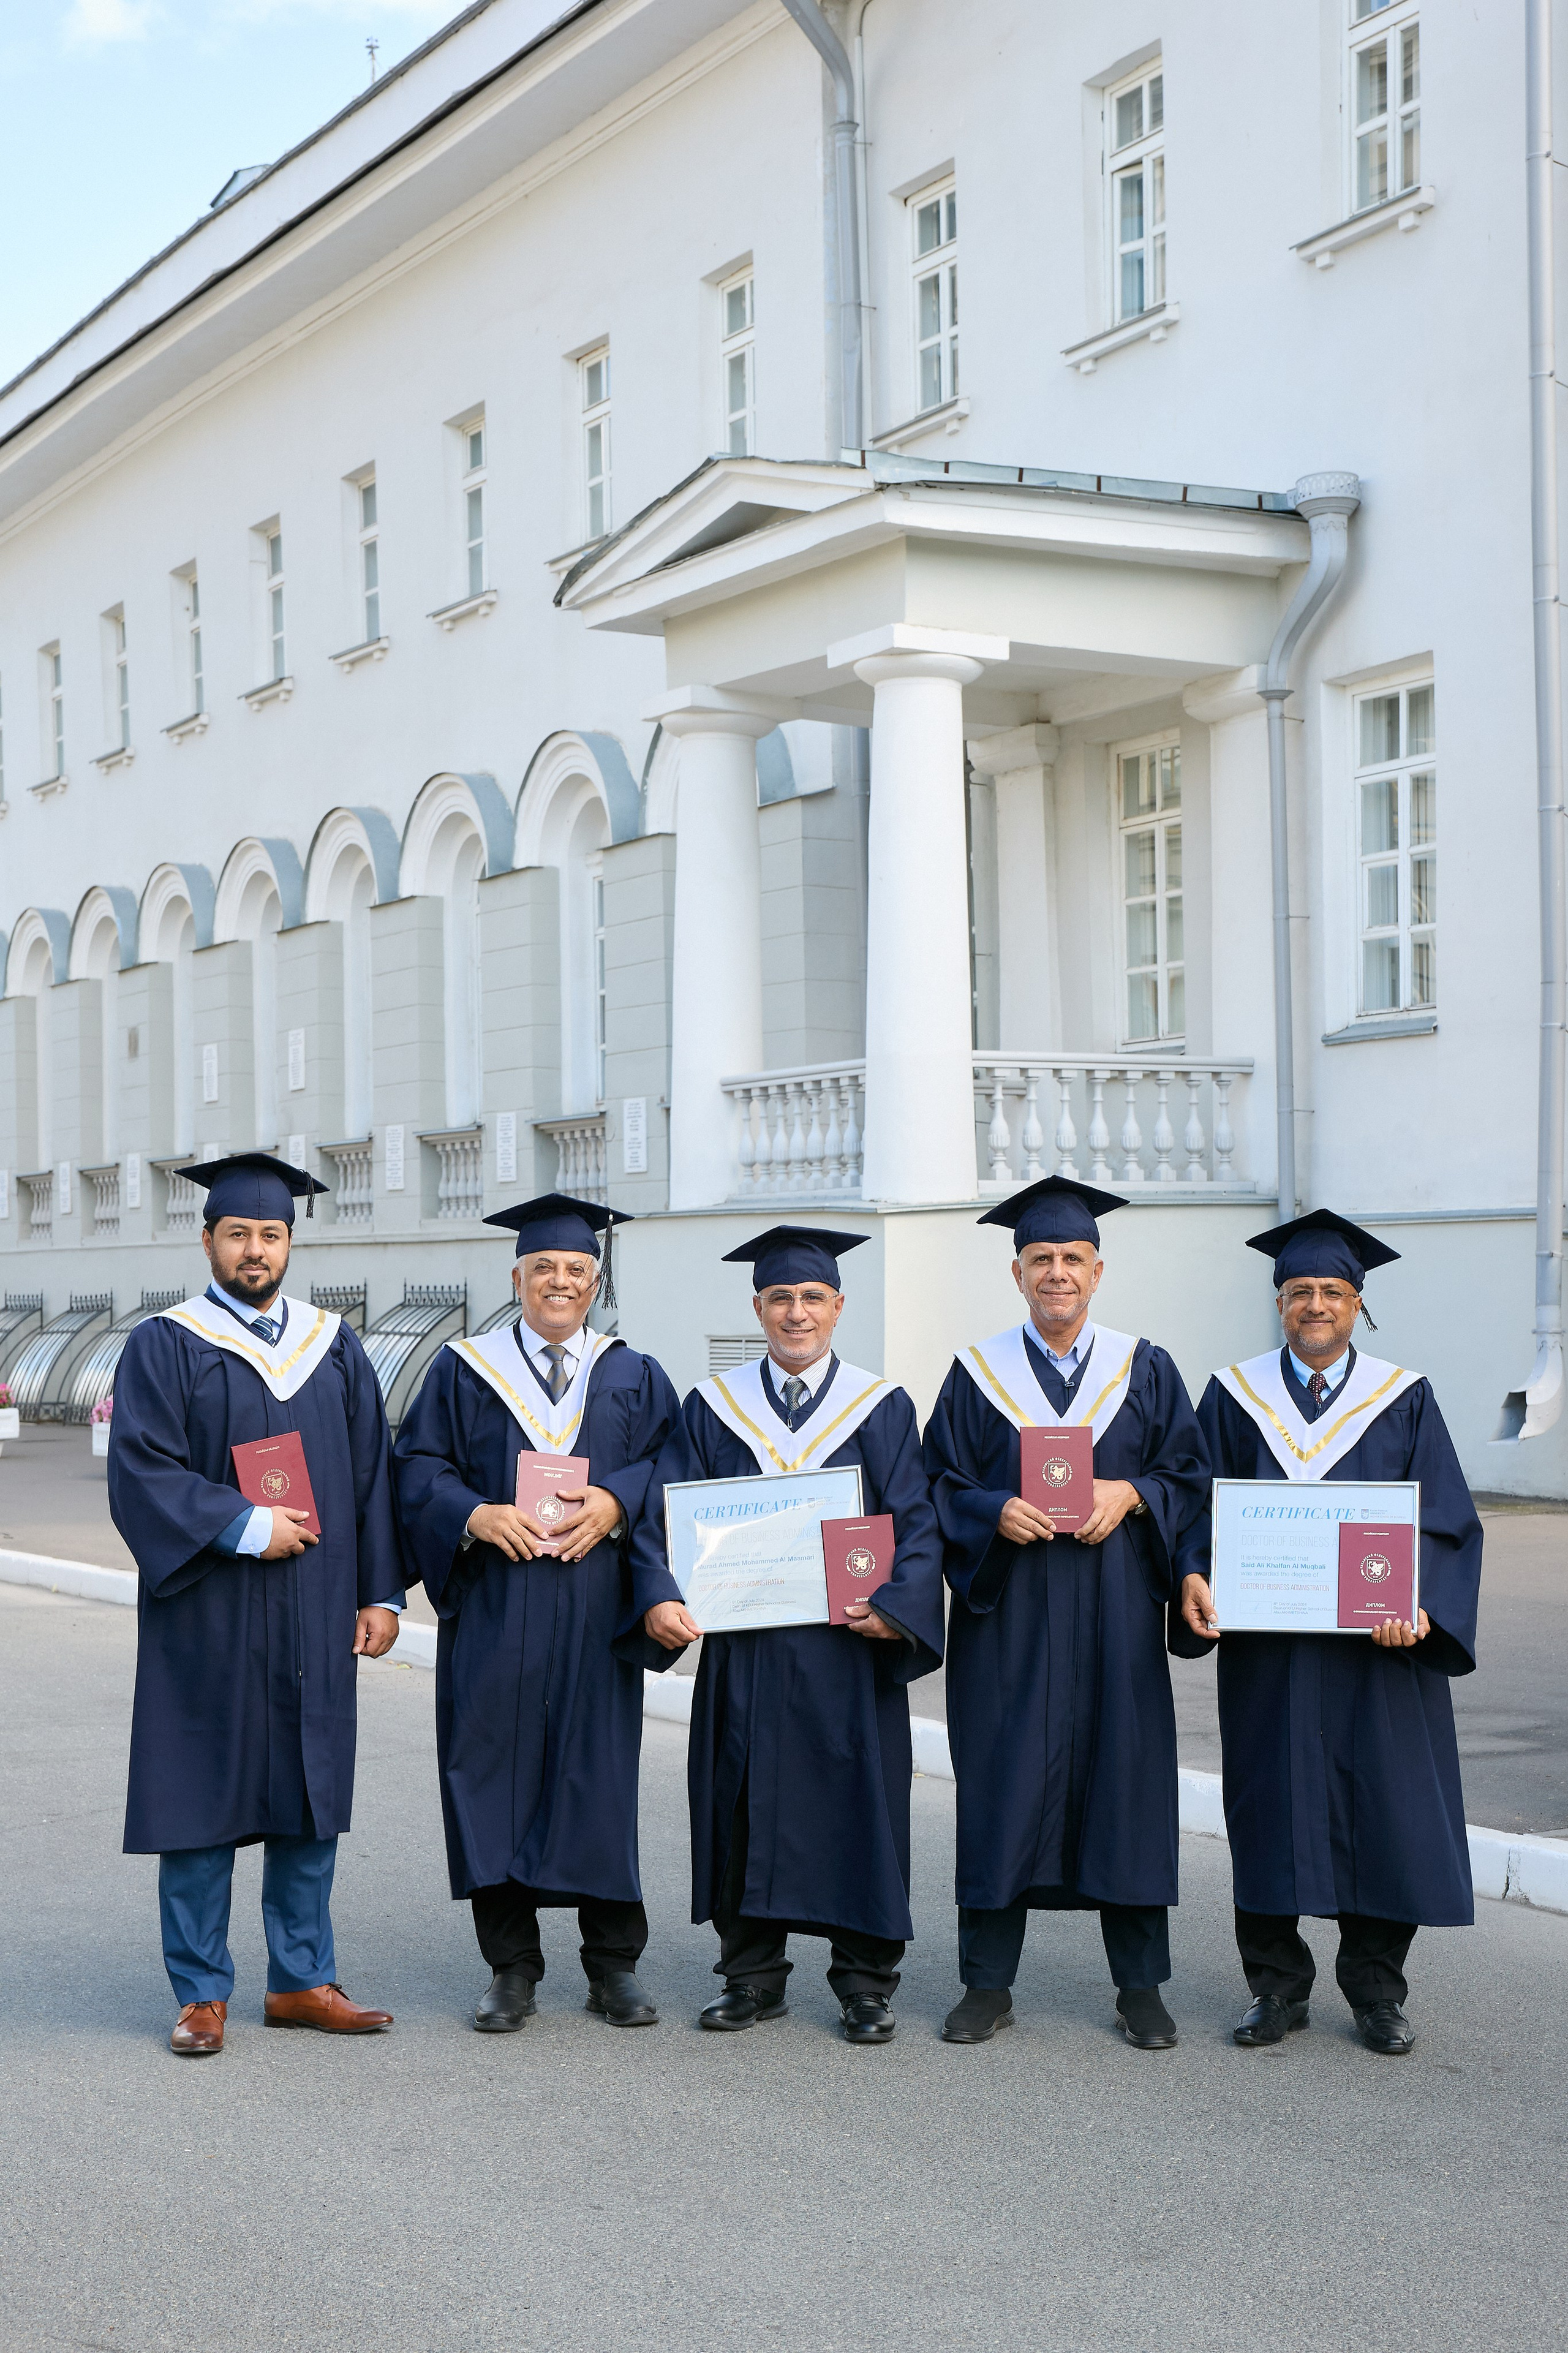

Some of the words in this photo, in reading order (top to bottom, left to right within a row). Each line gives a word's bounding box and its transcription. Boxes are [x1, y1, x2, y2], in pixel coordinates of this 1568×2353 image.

[694, 1498, 802, 1520] CERTIFICATE
[1242, 1506, 1355, 1520] CERTIFICATE
[1242, 1535, 1274, 1546] DOCTOR
[1276, 1535, 1287, 1547] OF
[1289, 1536, 1329, 1547] BUSINESS
[742, 1558, 778, 1566] Mohammed
[788, 1554, 815, 1562] Maamari
[746, 1566, 766, 1575] degree
[698, 1582, 716, 1592] DOCTOR
[717, 1582, 723, 1590] OF
[724, 1580, 746, 1590] BUSINESS
[747, 1578, 785, 1588] ADMINISTRATION
